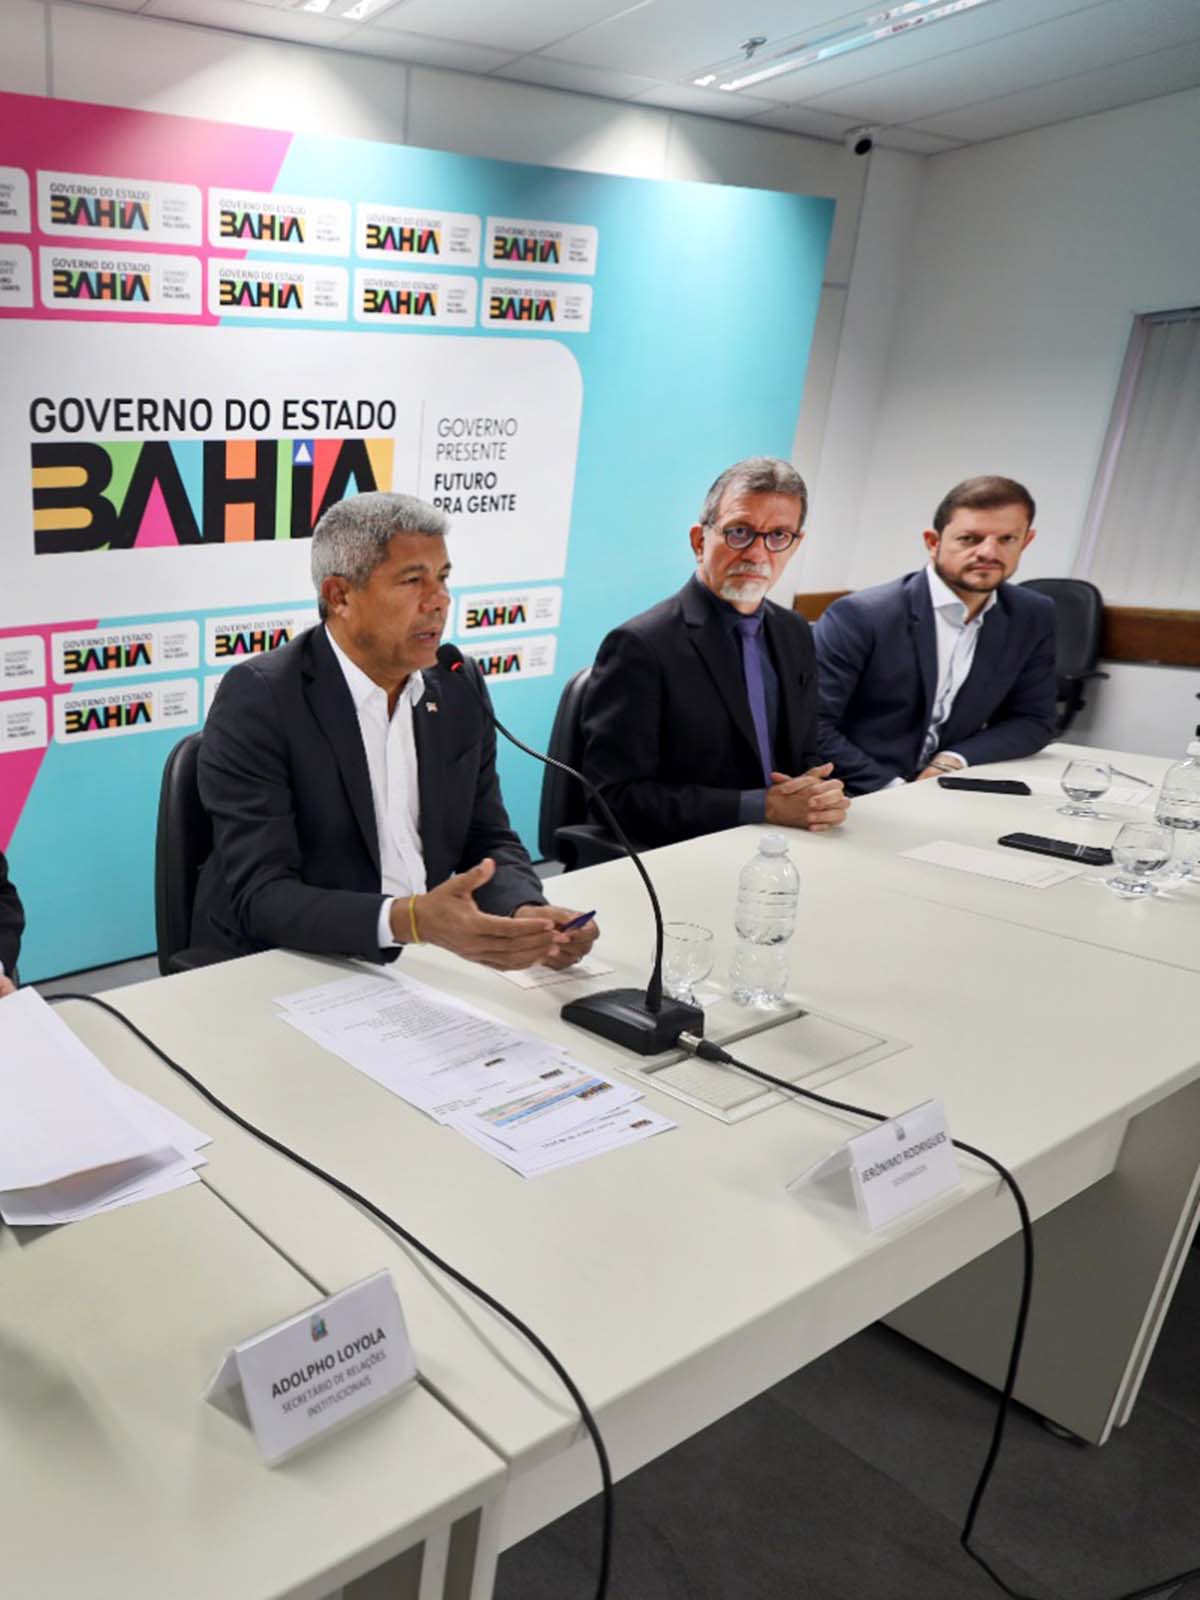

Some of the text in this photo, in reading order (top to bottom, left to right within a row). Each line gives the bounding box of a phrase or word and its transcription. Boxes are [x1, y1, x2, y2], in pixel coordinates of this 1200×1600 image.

[49, 182, 149, 200] GOVERNO DO ESTADO
[50, 194, 149, 231] BAHIA
[219, 210, 305, 243] BAHIA
[365, 224, 440, 254] BAHIA
[493, 235, 561, 264] BAHIA
[51, 257, 150, 272] GOVERNO DO ESTADO
[52, 269, 150, 302] BAHIA
[219, 279, 304, 309] BAHIA
[363, 288, 438, 316] BAHIA
[489, 296, 556, 322] BAHIA
[29, 397, 396, 433] GOVERNO DO ESTADO
[437, 417, 518, 438] GOVERNO
[436, 441, 507, 462] PRESENTE
[30, 439, 386, 555] BAHIA
[433, 472, 498, 492] FUTURO
[467, 494, 517, 515] GENTE
[465, 602, 528, 629] BAHIA
[63, 631, 152, 650] GOVERNO DO ESTADO
[214, 627, 290, 657] BAHIA
[63, 640, 152, 674] BAHIA
[64, 690, 152, 710] GOVERNO DO ESTADO
[65, 699, 152, 734] BAHIA
[271, 1327, 387, 1399] ADOLPHO LOYOLA
[281, 1380, 334, 1415] SECRETÁRIO
[335, 1372, 346, 1386] DE
[306, 1376, 373, 1418] INSTITUCIONAIS
